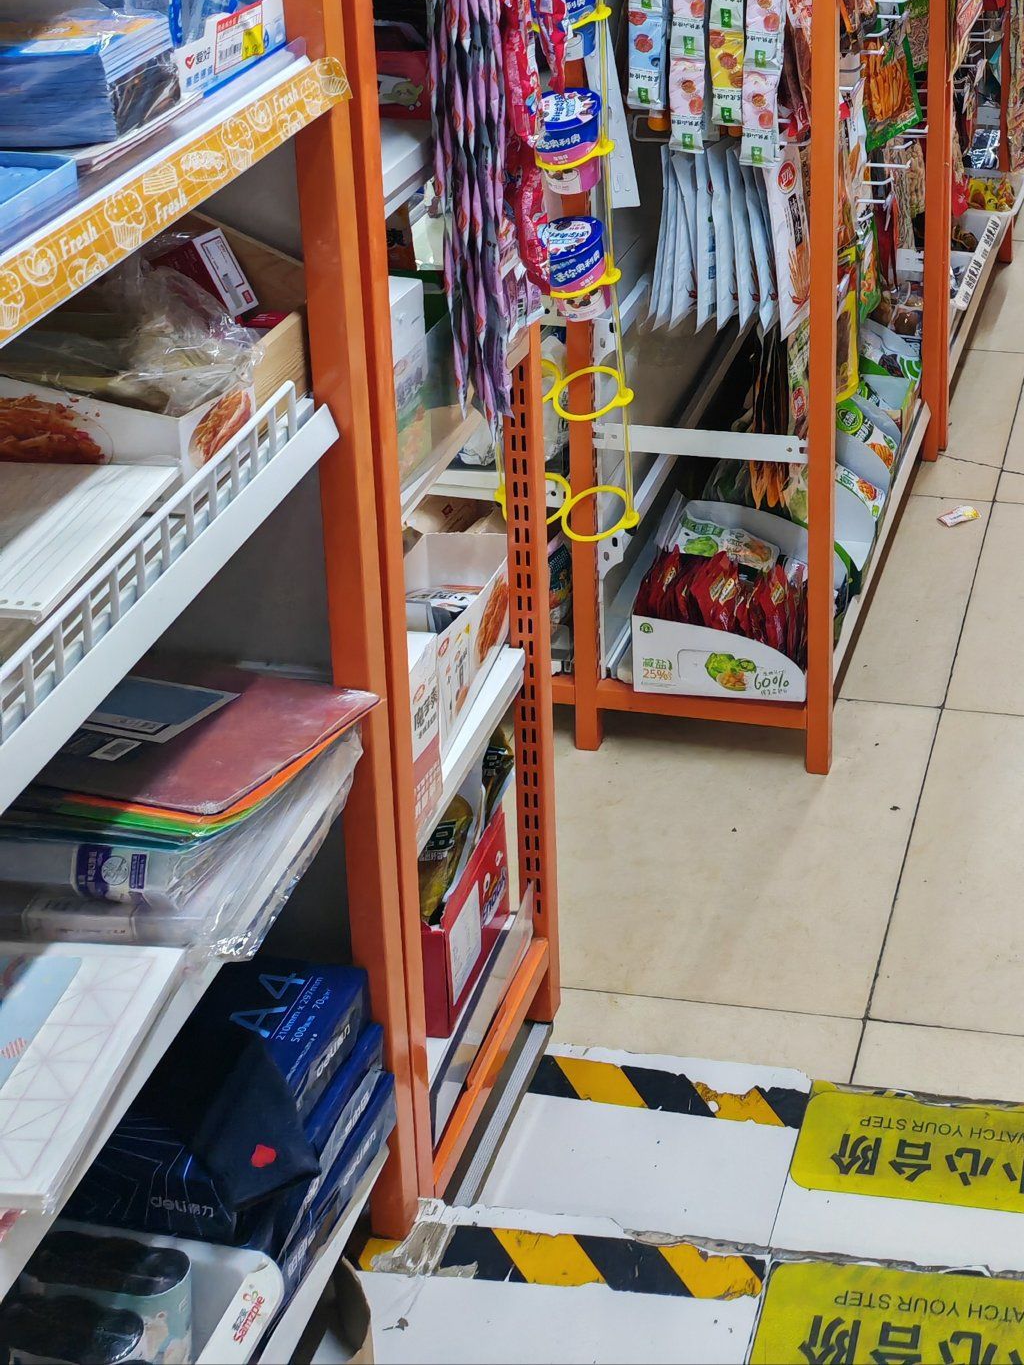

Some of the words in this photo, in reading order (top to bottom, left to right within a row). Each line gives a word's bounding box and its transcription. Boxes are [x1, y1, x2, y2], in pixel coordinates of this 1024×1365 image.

[273, 87, 300, 114] Fresh
[154, 191, 189, 224] Fresh
[61, 224, 98, 257] Fresh
[754, 673, 790, 690] 60%
[229, 972, 305, 1039] A4
[859, 1115, 908, 1132] STEP
[913, 1120, 965, 1138] YOUR
[834, 1289, 892, 1309] STEP
[898, 1296, 960, 1318] YOUR
